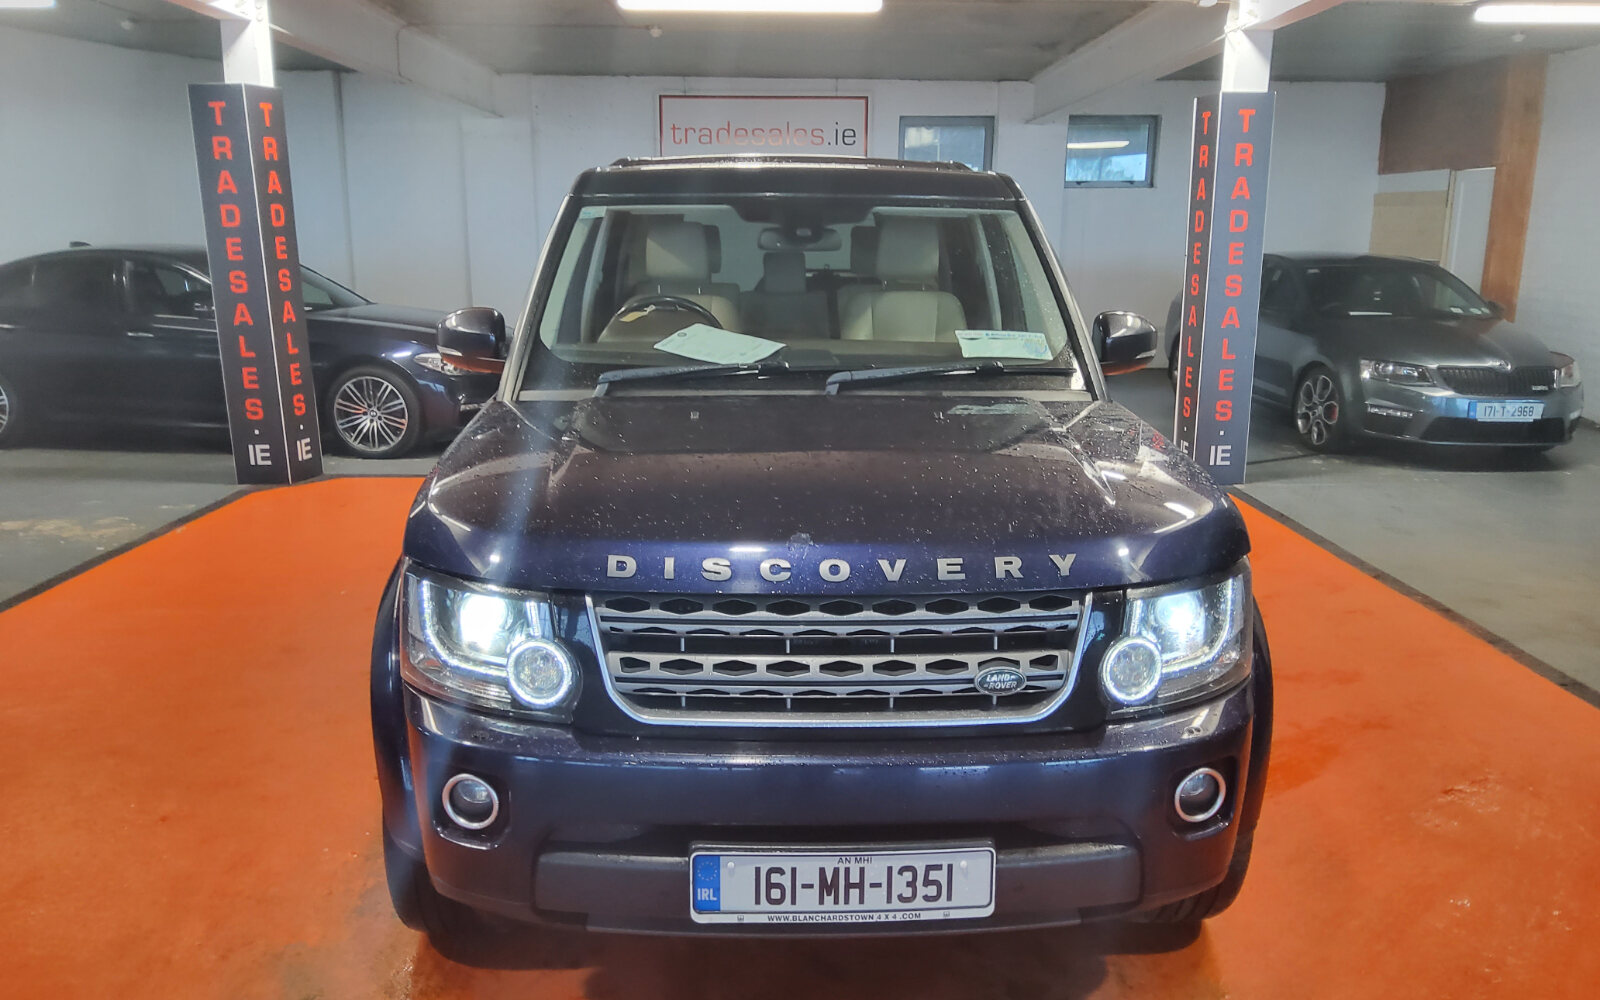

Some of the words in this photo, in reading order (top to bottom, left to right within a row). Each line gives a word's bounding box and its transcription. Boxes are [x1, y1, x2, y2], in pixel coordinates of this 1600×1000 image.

[670, 121, 857, 146] tradesales.ie
[1484, 405, 1535, 417] 171-T-2968
[606, 553, 1077, 583] DISCOVERY
[837, 856, 852, 865] AN
[754, 863, 954, 906] 161-MH-1351
[697, 888, 718, 901] IRL
